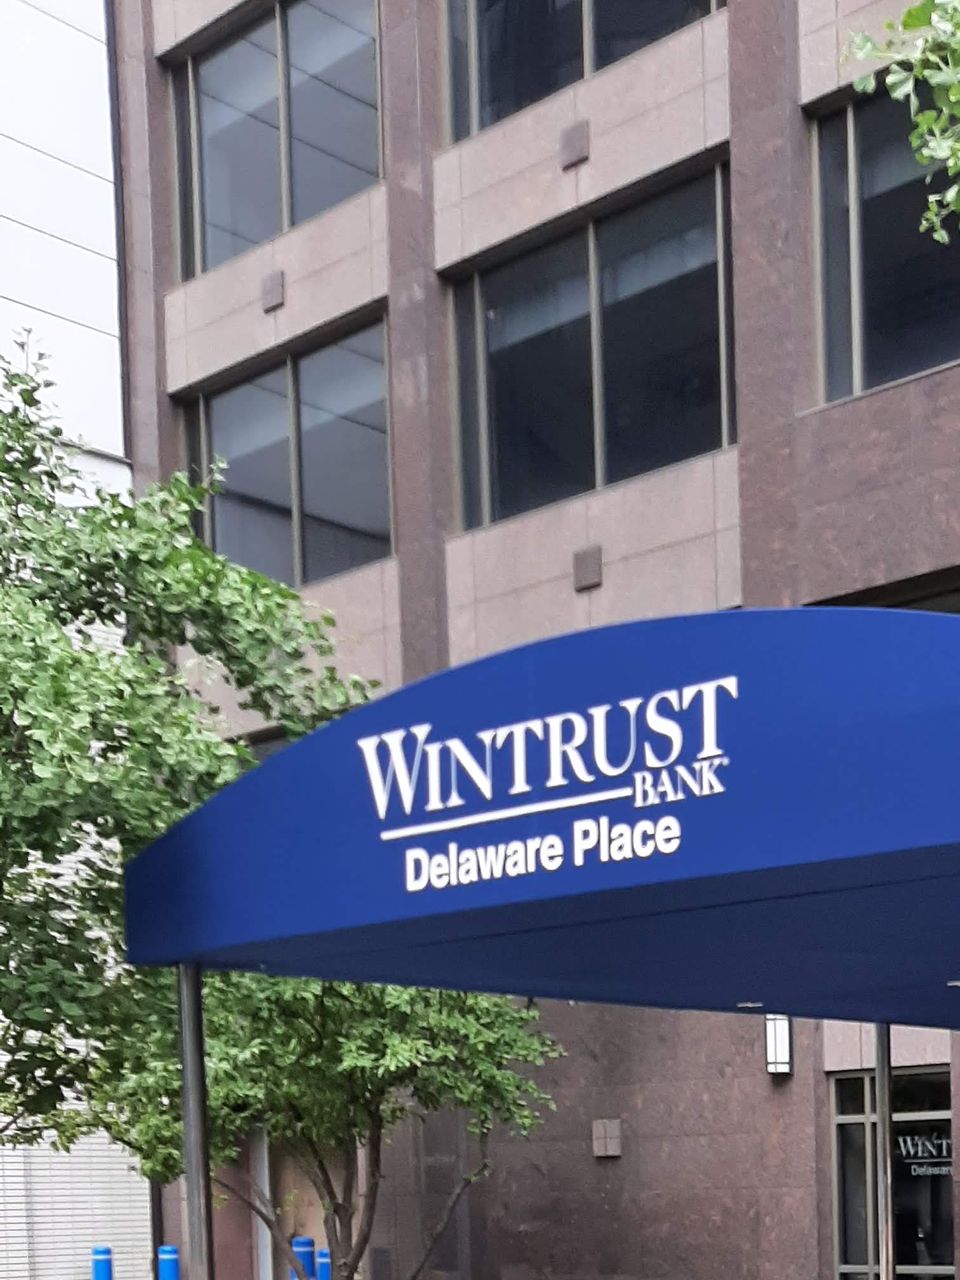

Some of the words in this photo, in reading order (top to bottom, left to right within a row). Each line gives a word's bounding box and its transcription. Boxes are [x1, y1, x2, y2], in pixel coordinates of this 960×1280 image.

[357, 675, 739, 821] WINTRUST
[633, 757, 730, 808] BANK
[405, 832, 565, 892] Delaware
[573, 815, 682, 866] Place
